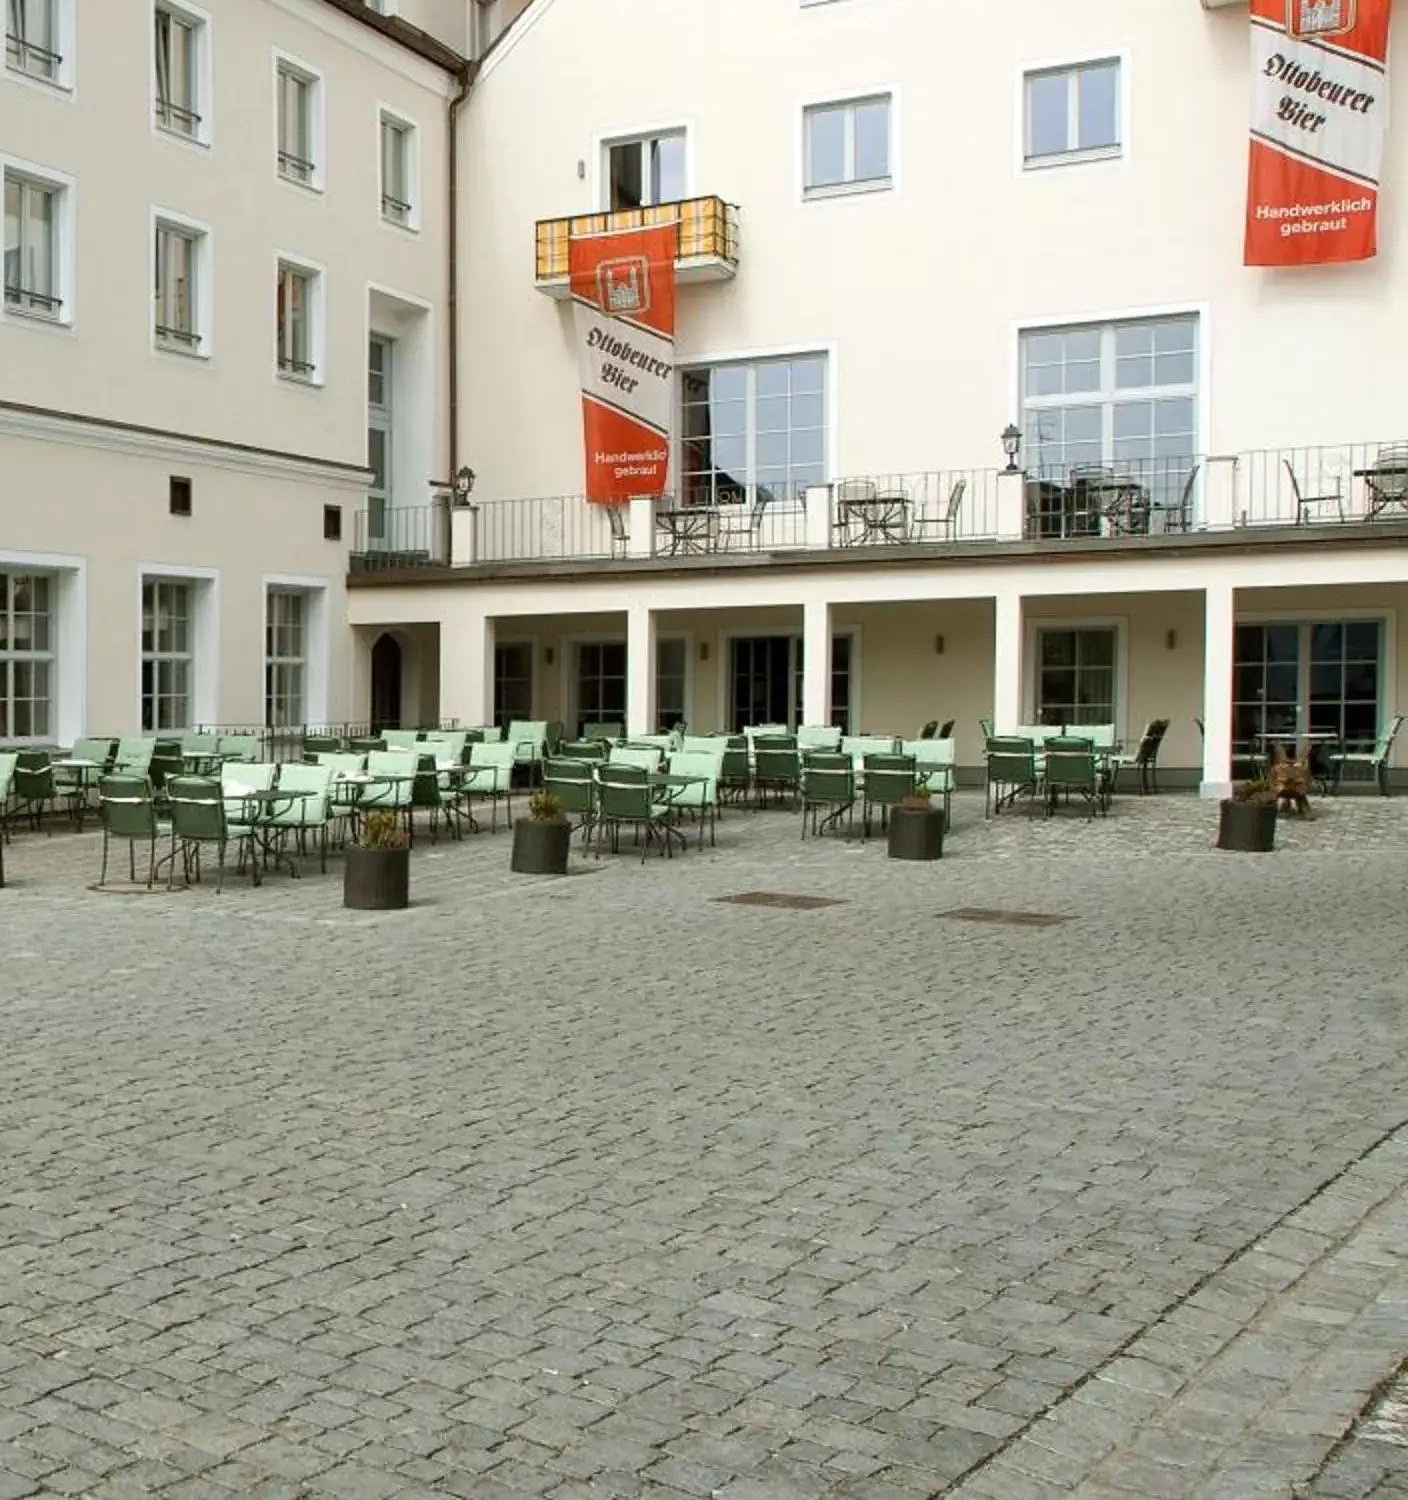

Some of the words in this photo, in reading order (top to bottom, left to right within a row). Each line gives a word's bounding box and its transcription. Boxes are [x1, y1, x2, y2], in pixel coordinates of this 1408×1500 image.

[1262, 53, 1375, 114] Ottobeurer
[1276, 95, 1327, 133] Bier
[1256, 197, 1372, 219] Handwerklich
[1280, 217, 1348, 238] gebraut
[586, 326, 673, 381] Ottobeurer
[600, 362, 640, 394] Bier
